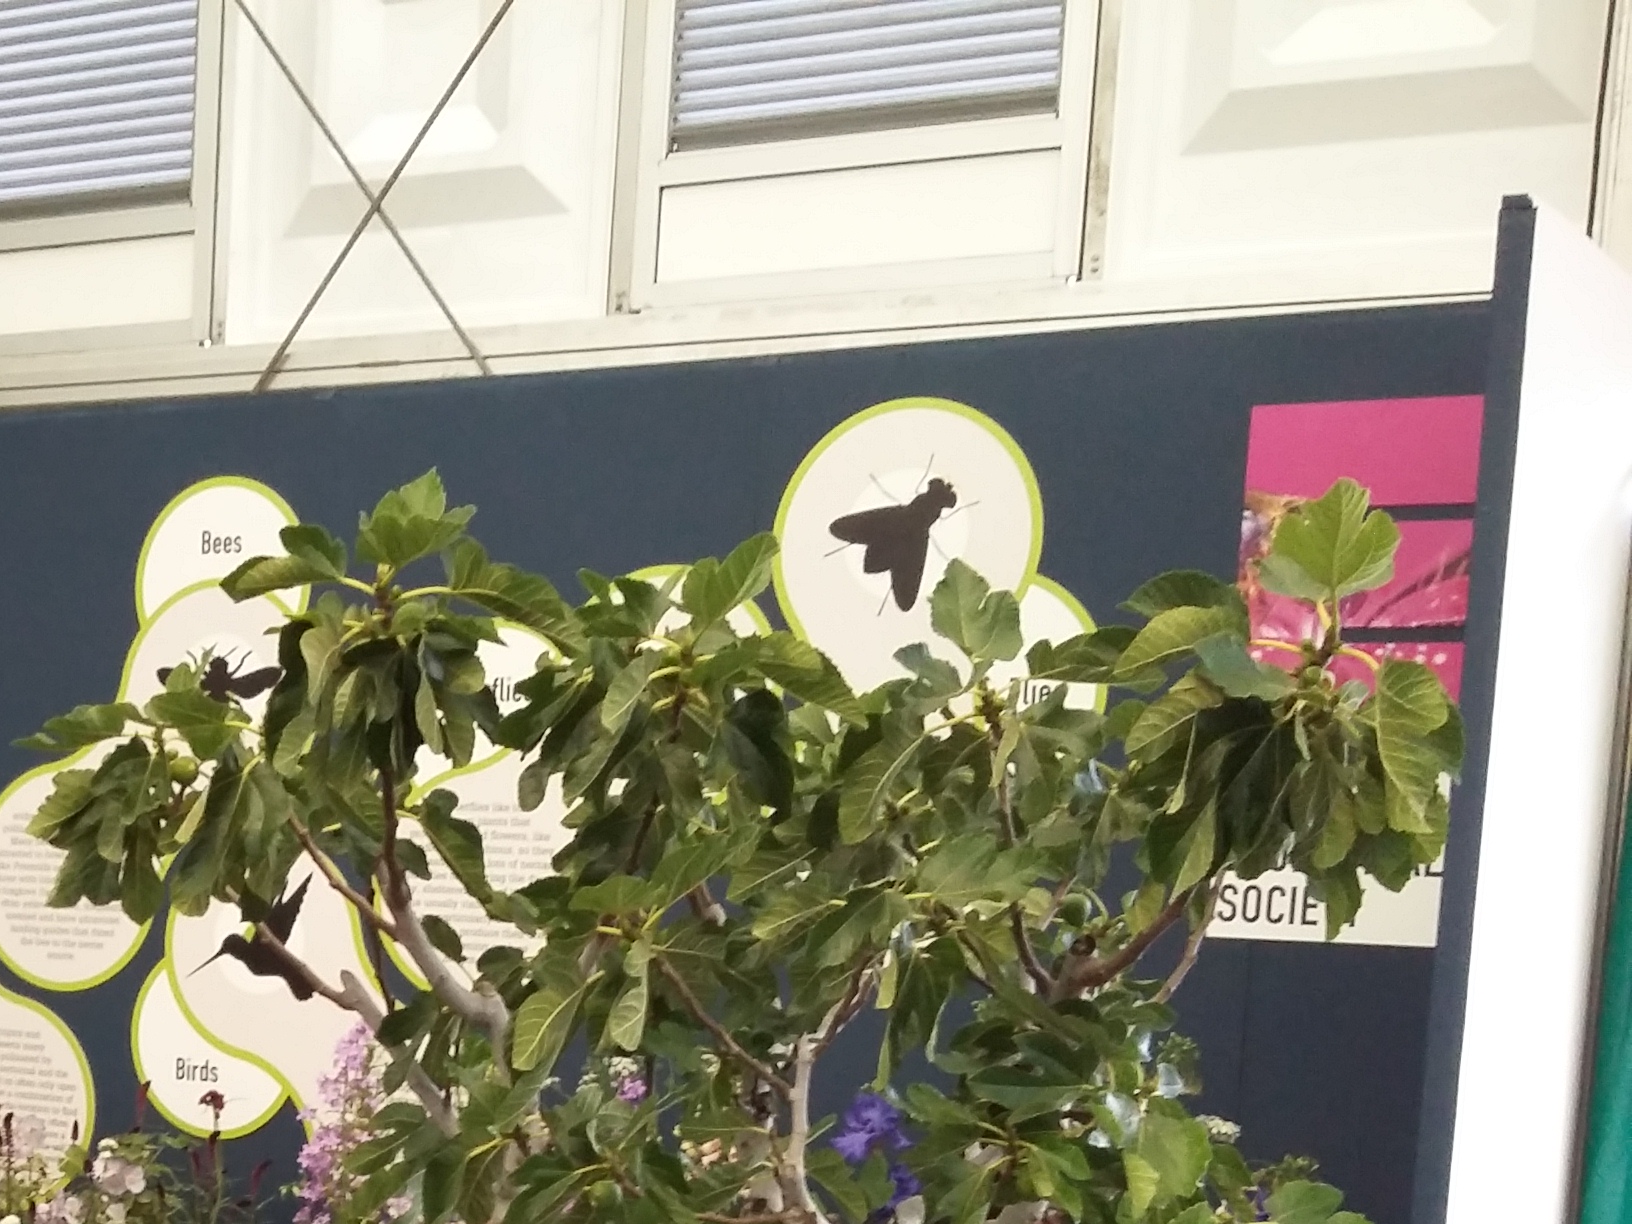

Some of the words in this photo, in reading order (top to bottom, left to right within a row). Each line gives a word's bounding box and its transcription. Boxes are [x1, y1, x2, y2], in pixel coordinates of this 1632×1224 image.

[201, 531, 243, 555] Bees
[1218, 883, 1353, 927] SOCIE
[176, 1057, 219, 1083] Birds
